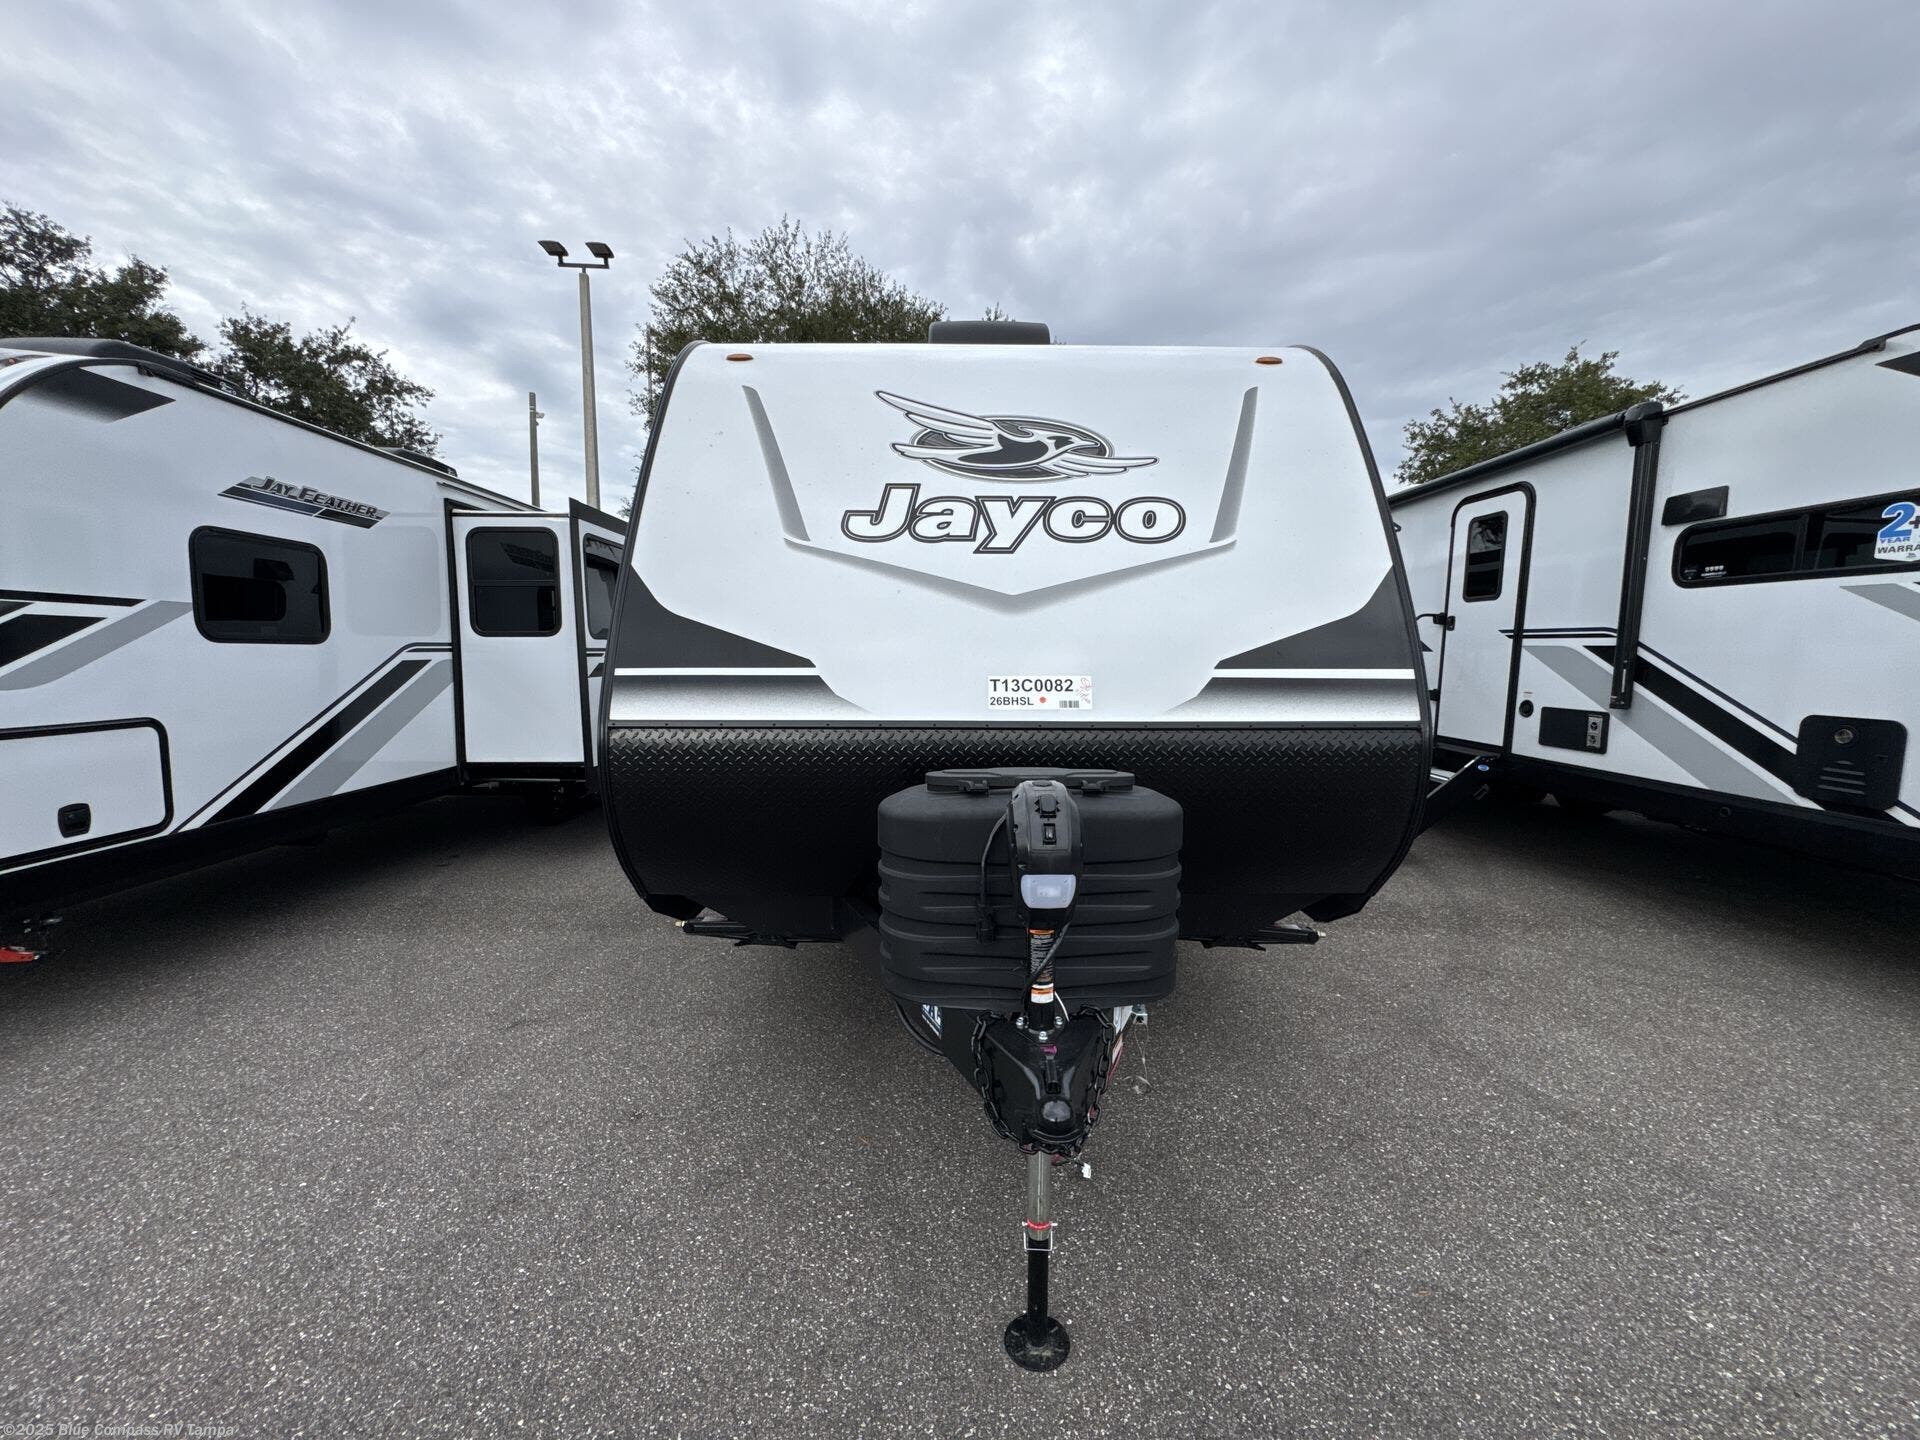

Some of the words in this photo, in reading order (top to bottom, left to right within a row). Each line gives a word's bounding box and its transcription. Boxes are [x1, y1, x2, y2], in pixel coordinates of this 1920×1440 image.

[840, 483, 1187, 554] Jayco
[989, 679, 1074, 692] T13C0082
[989, 696, 1034, 706] 26BHSL
